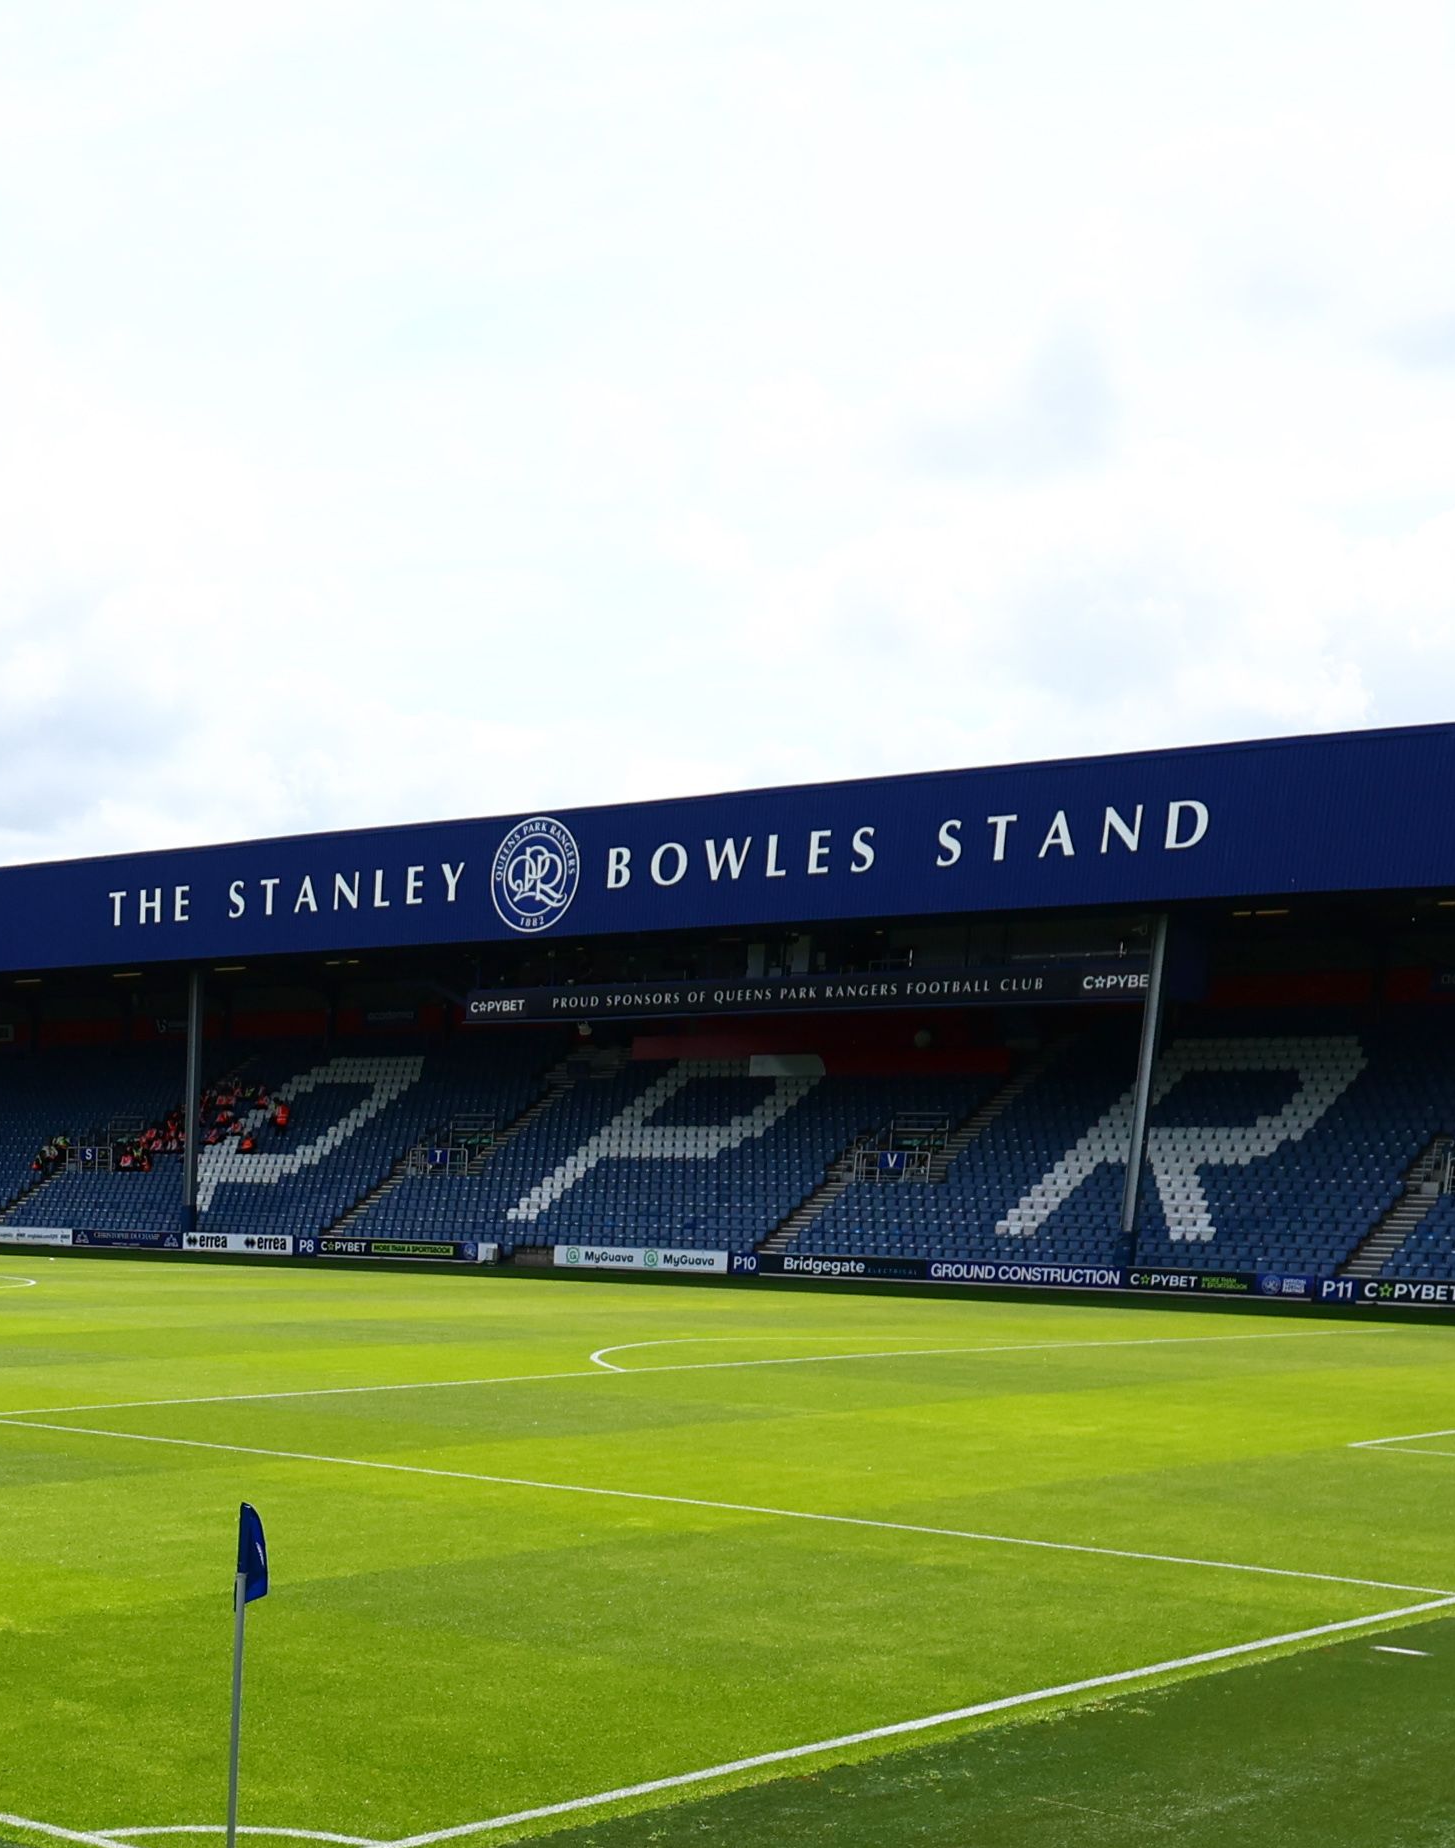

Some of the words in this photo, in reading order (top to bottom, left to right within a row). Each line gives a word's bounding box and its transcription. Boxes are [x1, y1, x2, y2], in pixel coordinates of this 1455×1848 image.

[523, 821, 548, 837] PARK
[109, 886, 190, 926] THE
[229, 862, 465, 918] STANLEY
[607, 826, 876, 889] BOWLES
[937, 800, 1209, 867] STAND
[552, 995, 600, 1009] PROUD
[606, 991, 680, 1007] SPONSORS
[688, 991, 707, 1004] OF
[714, 988, 772, 1005] QUEENS
[780, 987, 817, 1001] PARK
[825, 982, 898, 998] RANGERS
[906, 979, 991, 996] FOOTBALL
[1000, 977, 1044, 991] CLUB
[85, 1149, 93, 1160] S
[434, 1150, 443, 1162] T
[887, 1153, 898, 1168] V
[199, 1235, 228, 1248] errea
[257, 1236, 287, 1250] errea
[299, 1239, 314, 1252] P8
[585, 1251, 634, 1263] MyGuava
[663, 1255, 715, 1267] MyGuava
[733, 1256, 757, 1270] P10
[783, 1257, 865, 1275] Bridgegate
[930, 1263, 996, 1280] GROUND
[997, 1265, 1121, 1286] CONSTRUCTION
[1322, 1280, 1353, 1299] P11
